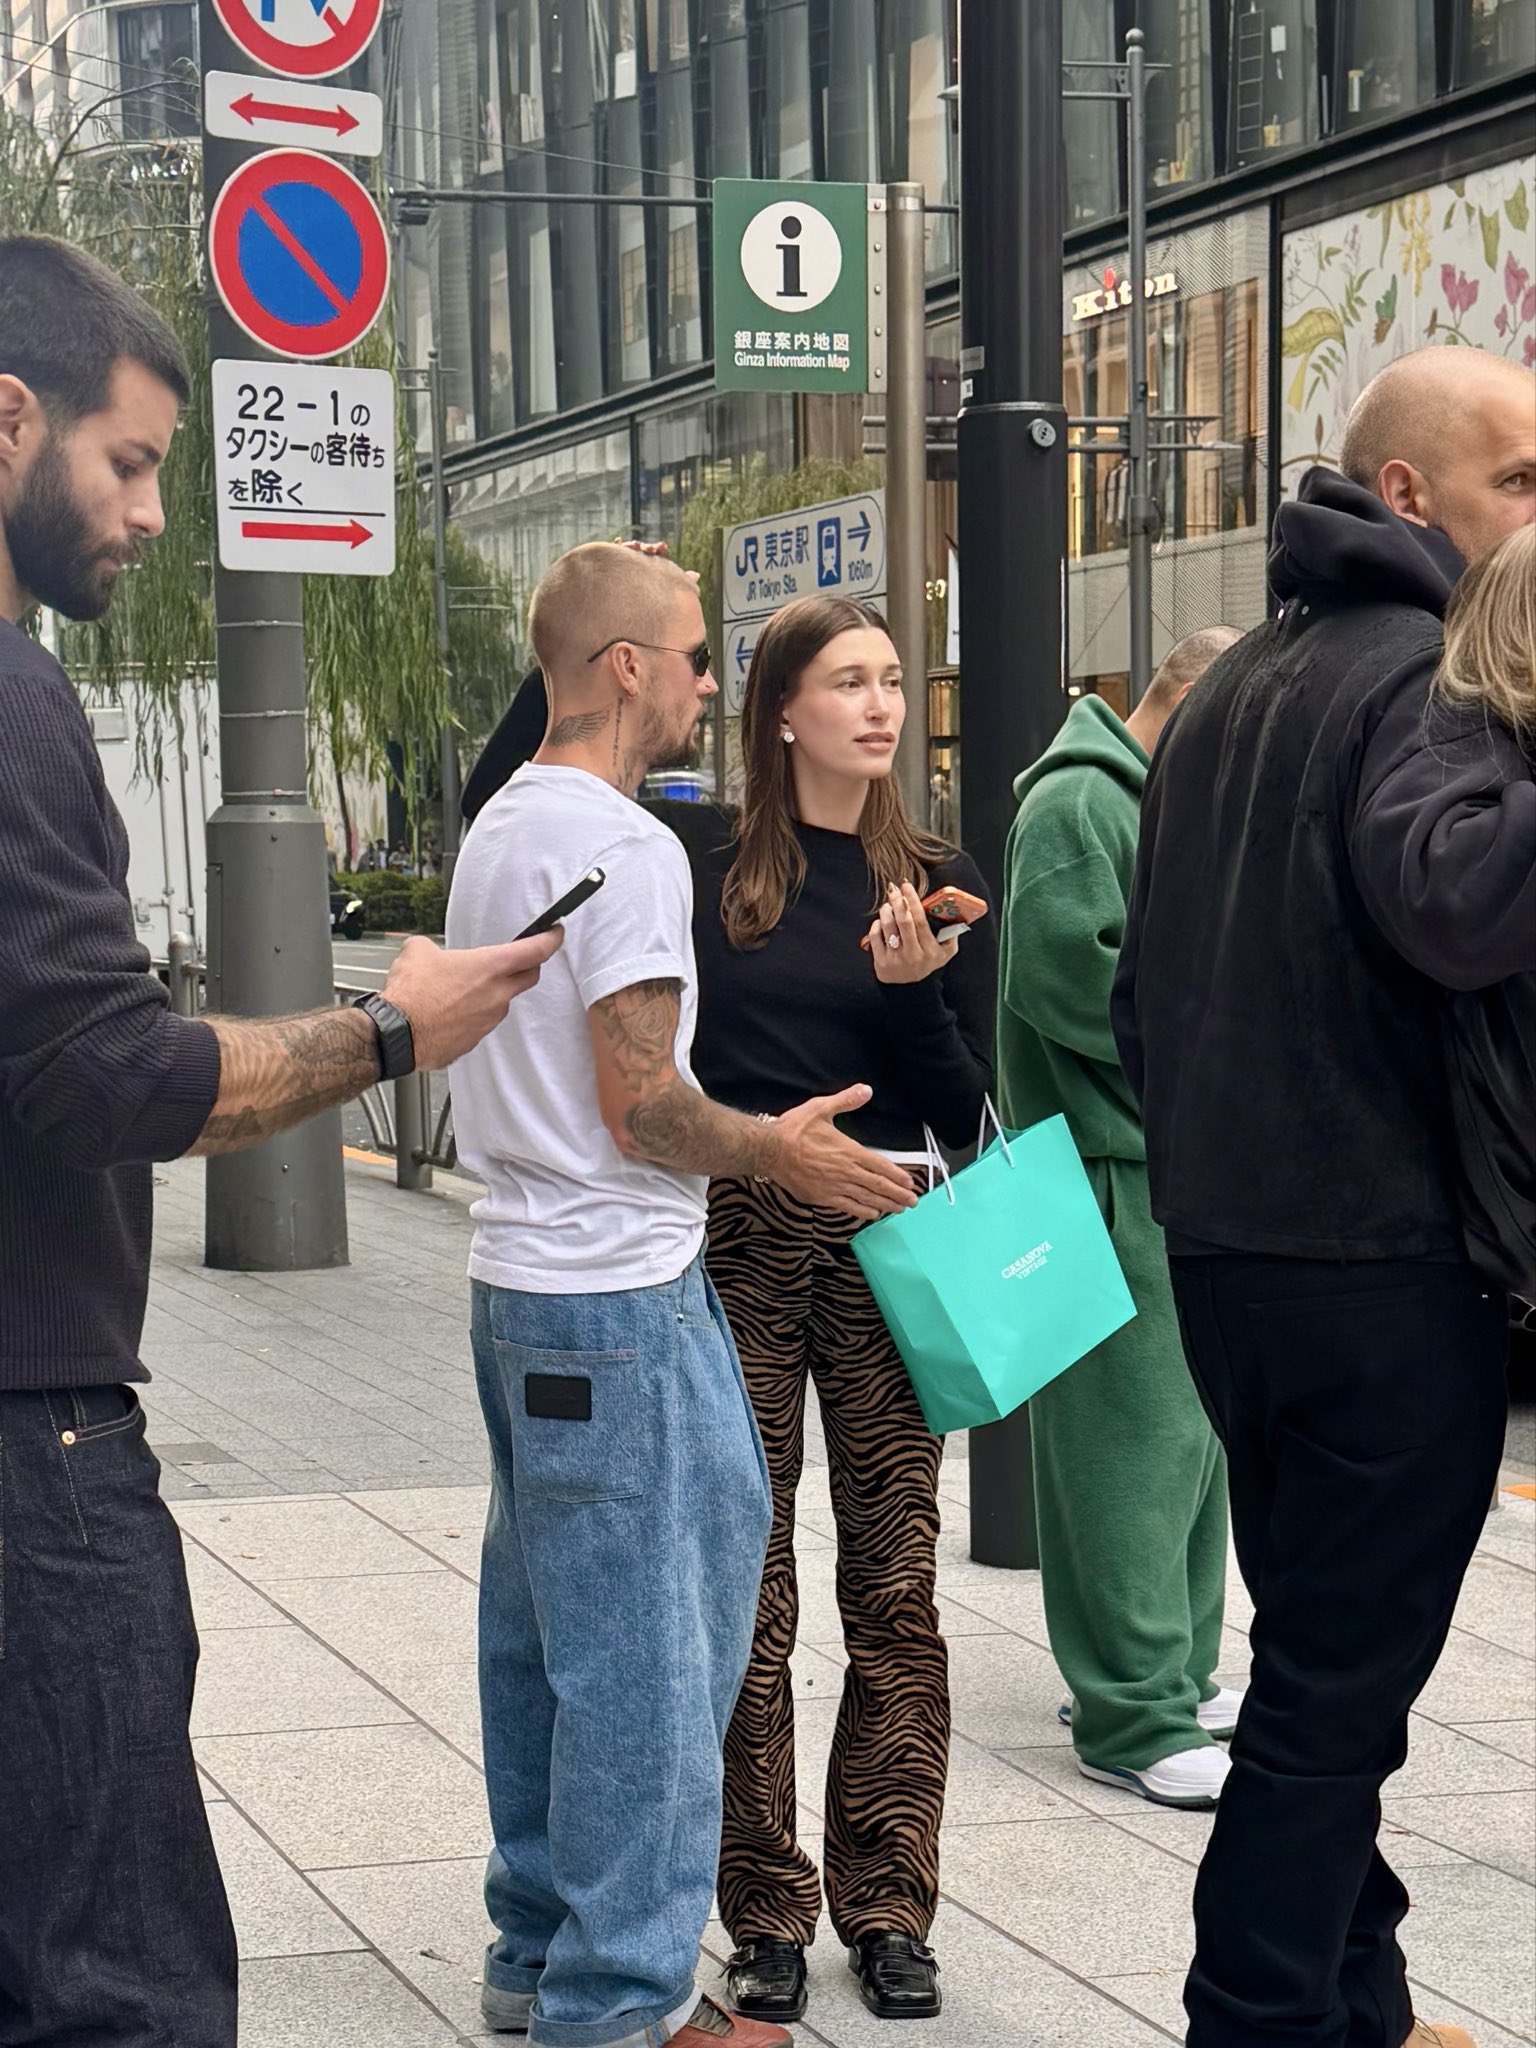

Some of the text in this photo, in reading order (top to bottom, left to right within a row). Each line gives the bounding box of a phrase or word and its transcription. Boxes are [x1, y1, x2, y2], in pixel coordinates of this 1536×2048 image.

[734, 330, 849, 351] 銀座案内地図
[734, 351, 850, 372] Ginza Information Map
[226, 427, 385, 468] タクシーの客待ち
[228, 469, 303, 505] を除く
[746, 580, 757, 602] JR
[758, 578, 781, 601] Tokyo
[1001, 1239, 1053, 1279] CASANOVA
